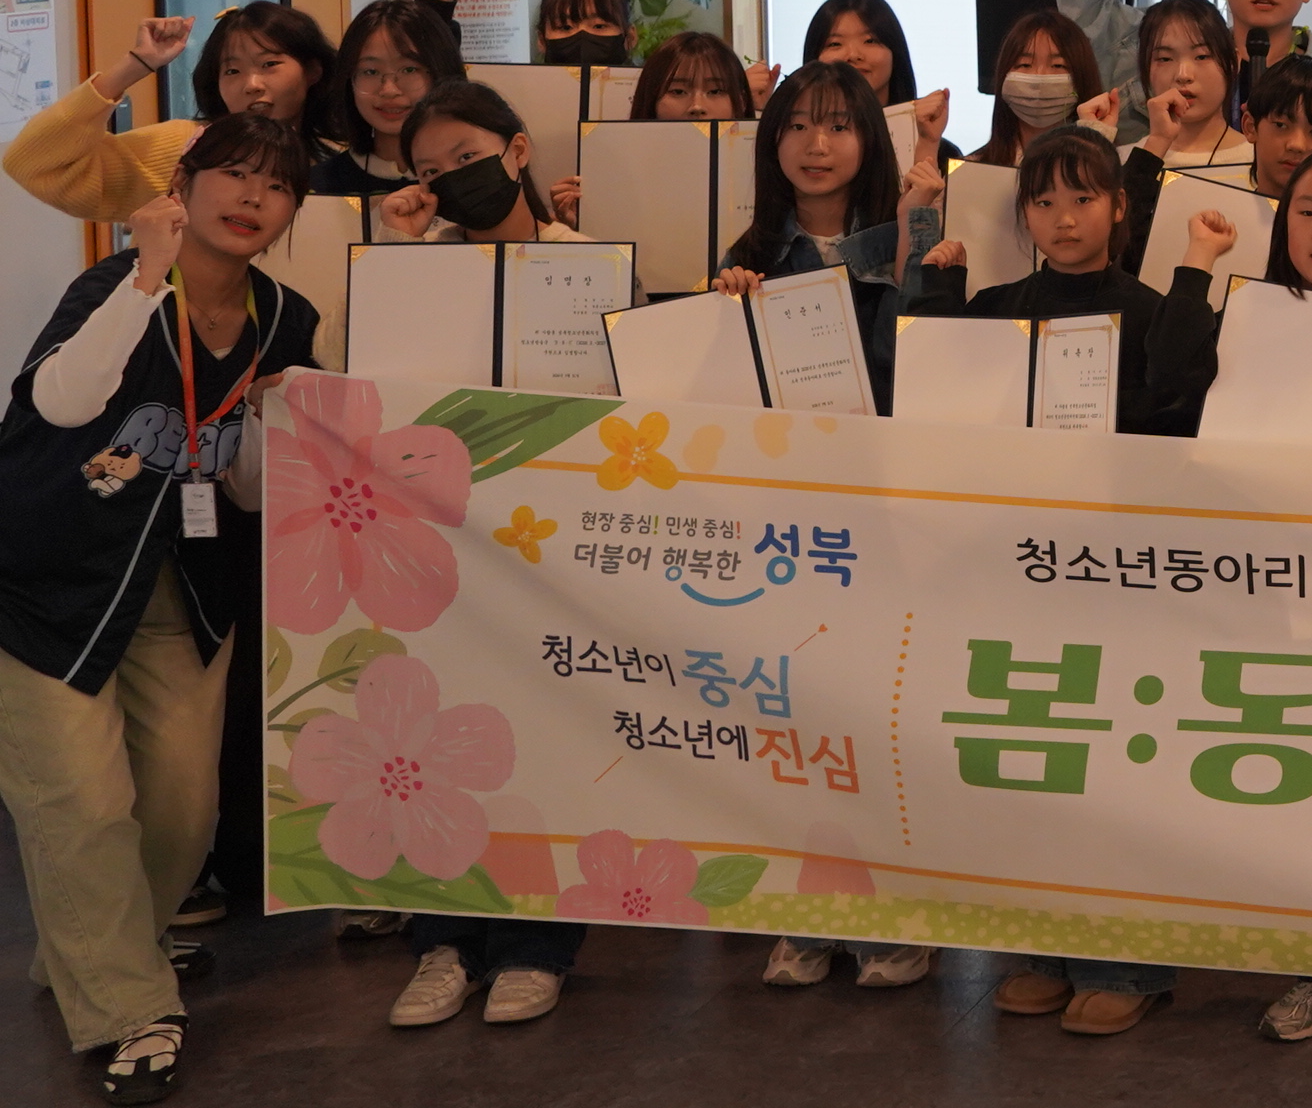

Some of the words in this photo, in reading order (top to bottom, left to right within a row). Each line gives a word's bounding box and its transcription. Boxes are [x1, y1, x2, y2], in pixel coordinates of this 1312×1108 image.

[574, 543, 652, 574] 더불어
[662, 546, 741, 582] 행복한
[754, 523, 858, 588] 성북
[581, 511, 615, 534] 현장
[619, 514, 659, 535] 중심!
[666, 516, 698, 538] 민생
[702, 519, 741, 541] 중심!
[1015, 537, 1308, 598] 청소년동아리
[541, 634, 676, 687] 청소년이
[681, 649, 792, 719] 중심
[613, 710, 749, 762] 청소년에
[754, 727, 860, 794] 진심
